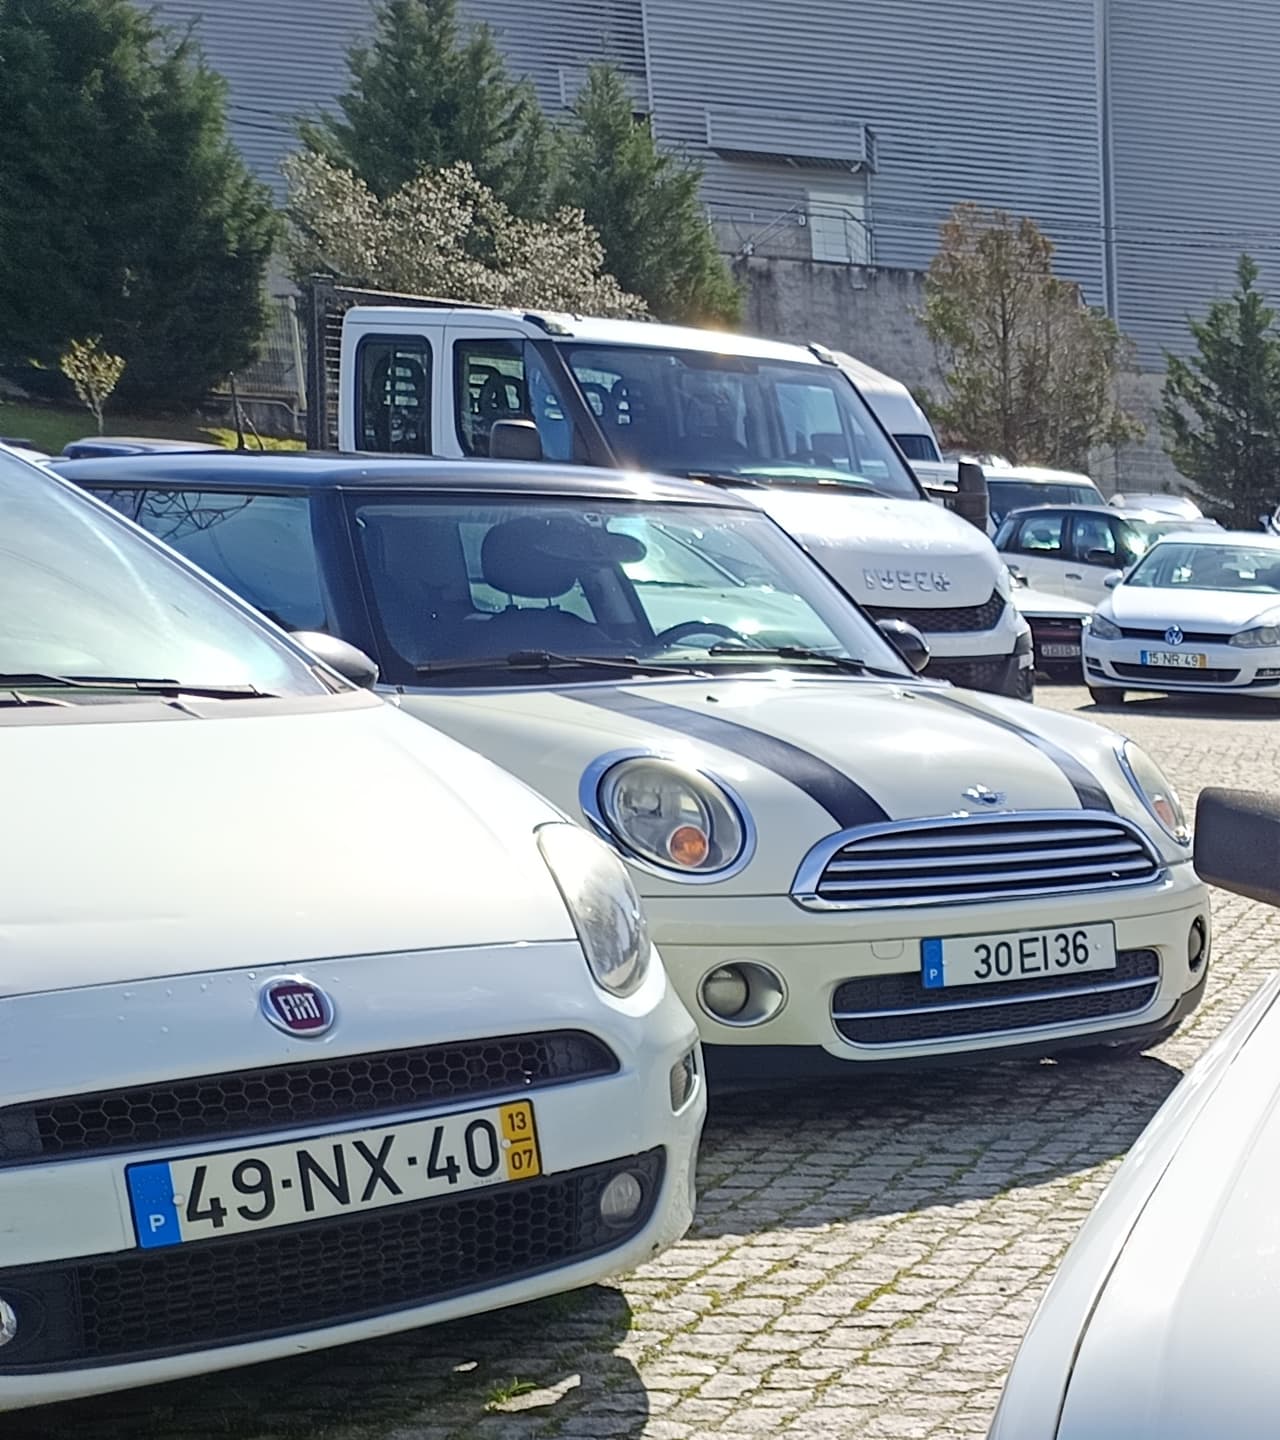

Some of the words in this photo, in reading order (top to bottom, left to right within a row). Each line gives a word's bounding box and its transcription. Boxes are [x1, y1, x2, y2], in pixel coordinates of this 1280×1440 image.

[930, 969, 938, 980] P
[277, 993, 320, 1022] FIAT
[507, 1110, 528, 1133] 13
[511, 1148, 534, 1171] 07
[150, 1213, 166, 1233] P
